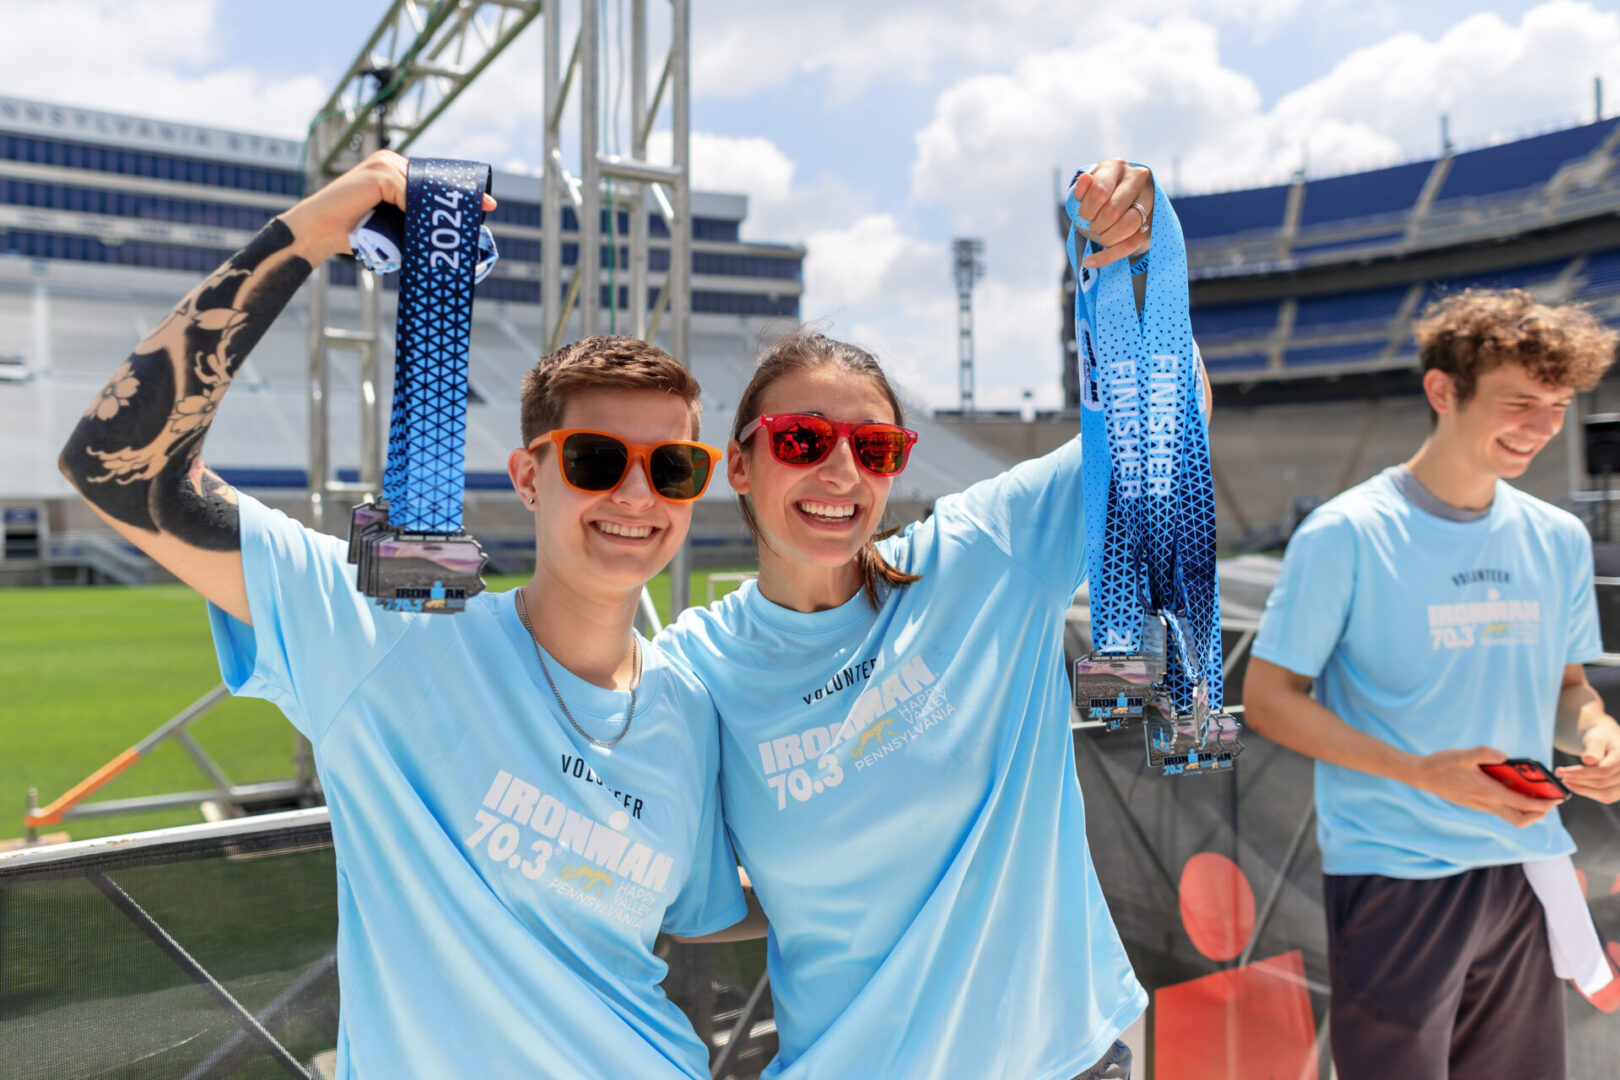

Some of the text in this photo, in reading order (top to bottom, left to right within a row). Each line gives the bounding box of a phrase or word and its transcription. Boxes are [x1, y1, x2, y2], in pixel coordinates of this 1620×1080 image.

[430, 190, 464, 269] 2024
[1110, 360, 1142, 499] FINISHER
[1149, 354, 1178, 496] FINISHER
[396, 581, 465, 598] IRONMAN
[1427, 588, 1541, 627] IRONMAN
[1430, 625, 1475, 651] 70.3
[758, 654, 937, 775] IRONMAN
[1091, 692, 1143, 707] IRONMAN
[1091, 707, 1112, 718] 70.3
[854, 703, 957, 772] PENNSYLVANIA
[1164, 748, 1212, 766] IRONMAN
[562, 754, 643, 820] VOLER
[767, 754, 844, 811] 70.3
[464, 809, 553, 880] 70.3
[482, 769, 674, 892] IRONMAN
[548, 878, 643, 929] PENNSYLVANIA
